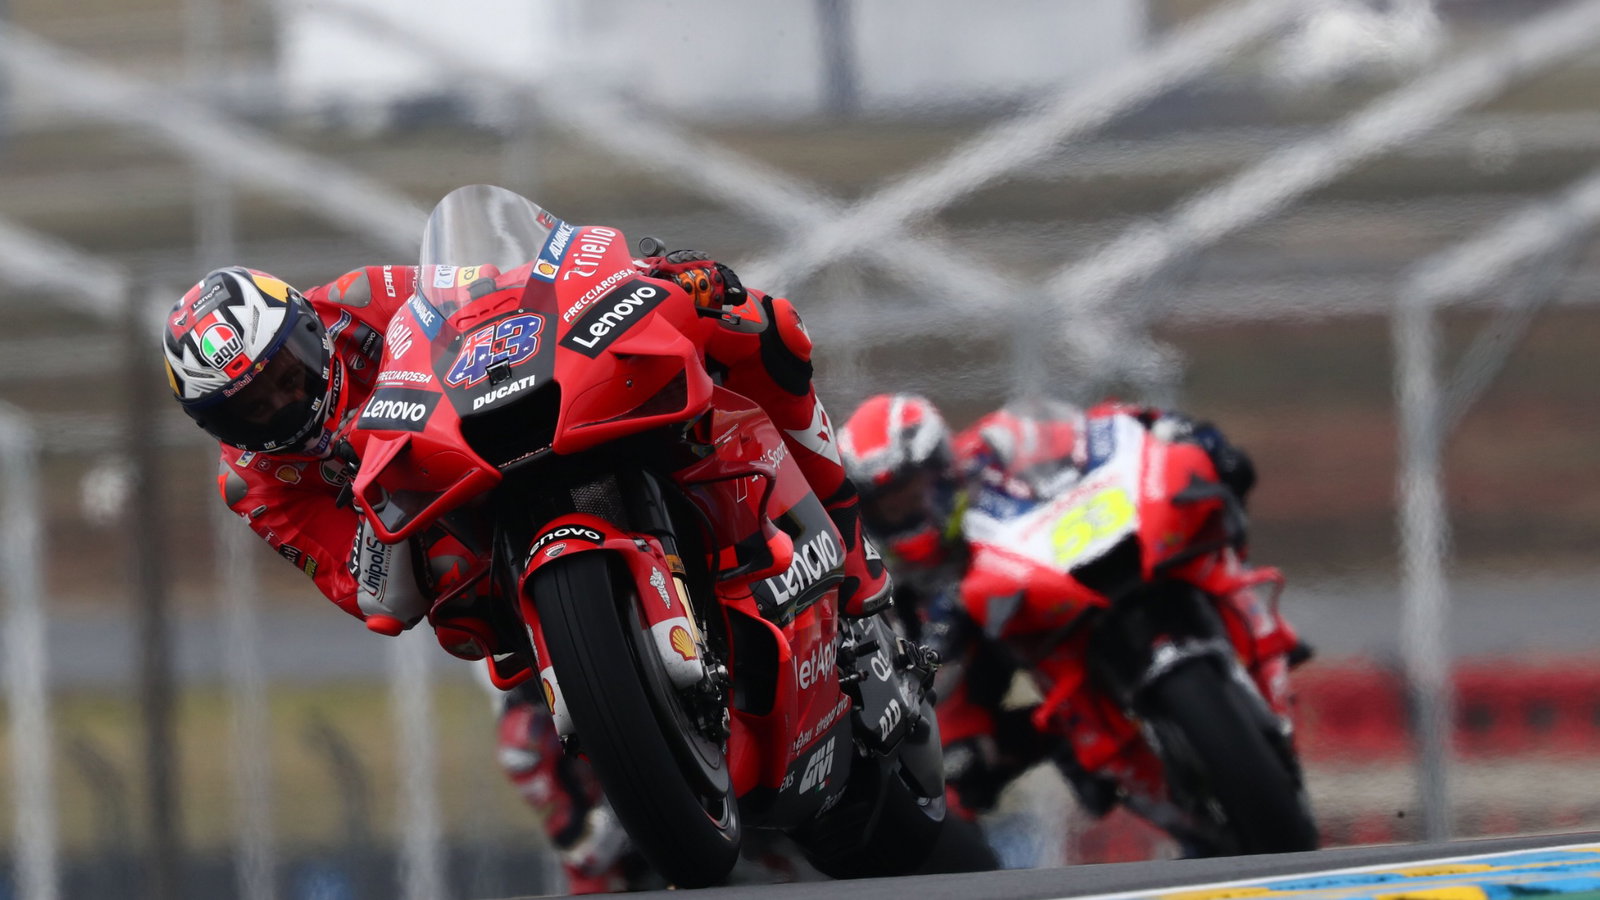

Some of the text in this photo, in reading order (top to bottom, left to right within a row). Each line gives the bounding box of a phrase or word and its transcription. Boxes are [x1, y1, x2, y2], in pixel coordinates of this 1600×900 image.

[548, 221, 574, 260] ADVANCE
[572, 228, 617, 267] riello
[192, 285, 220, 309] Lenovo
[563, 268, 635, 322] FRECCIAROSSA
[572, 286, 657, 348] Lenovo
[212, 338, 240, 366] agv
[444, 313, 545, 389] 43
[322, 366, 330, 380] CAT
[311, 397, 322, 411] CAT
[362, 396, 426, 421] Lenovo
[473, 374, 536, 410] DUCATI
[264, 441, 276, 449] CAT
[524, 527, 601, 568] Lenovo
[765, 529, 837, 606] Lenovo
